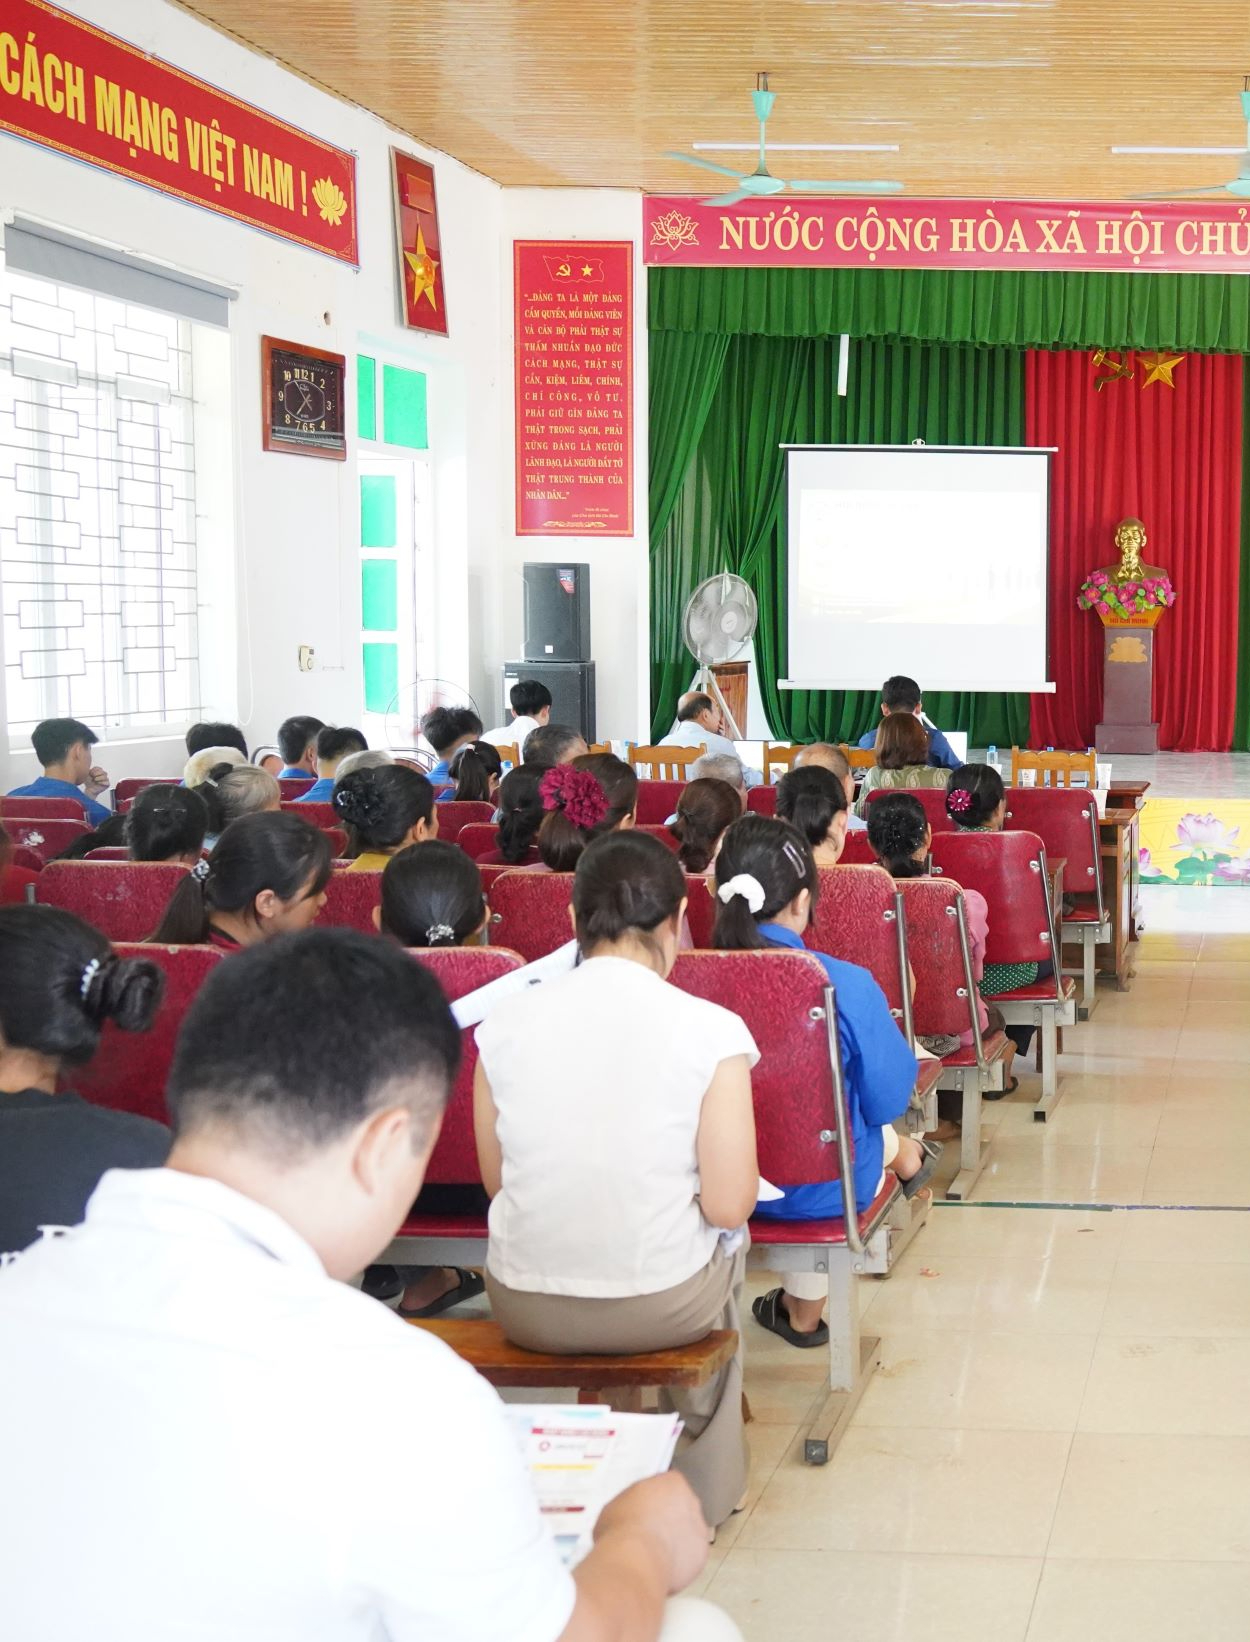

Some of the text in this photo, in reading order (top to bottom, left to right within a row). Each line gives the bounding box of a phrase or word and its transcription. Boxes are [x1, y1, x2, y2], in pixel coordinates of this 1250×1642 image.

[0, 31, 86, 125] CÁCH
[94, 74, 179, 163] MẠNG
[185, 116, 236, 192] VIỆT
[243, 143, 295, 211] NAM
[720, 205, 824, 251] NƯỚC
[835, 207, 940, 261] CỘNG
[949, 209, 1030, 253] HÒA
[1036, 210, 1087, 254] XÃ
[1096, 211, 1165, 264] HỘI
[556, 293, 565, 302] TA
[585, 344, 601, 355] ĐẠO
[284, 370, 291, 381] 10
[301, 369, 309, 380] 12
[320, 378, 325, 389] 2
[278, 391, 284, 401] 9
[326, 401, 332, 411] 3
[285, 415, 291, 424] 8
[613, 410, 623, 420] TA
[303, 422, 308, 433] 6
[549, 425, 574, 435] TRONG
[549, 475, 574, 485] TRUNG
